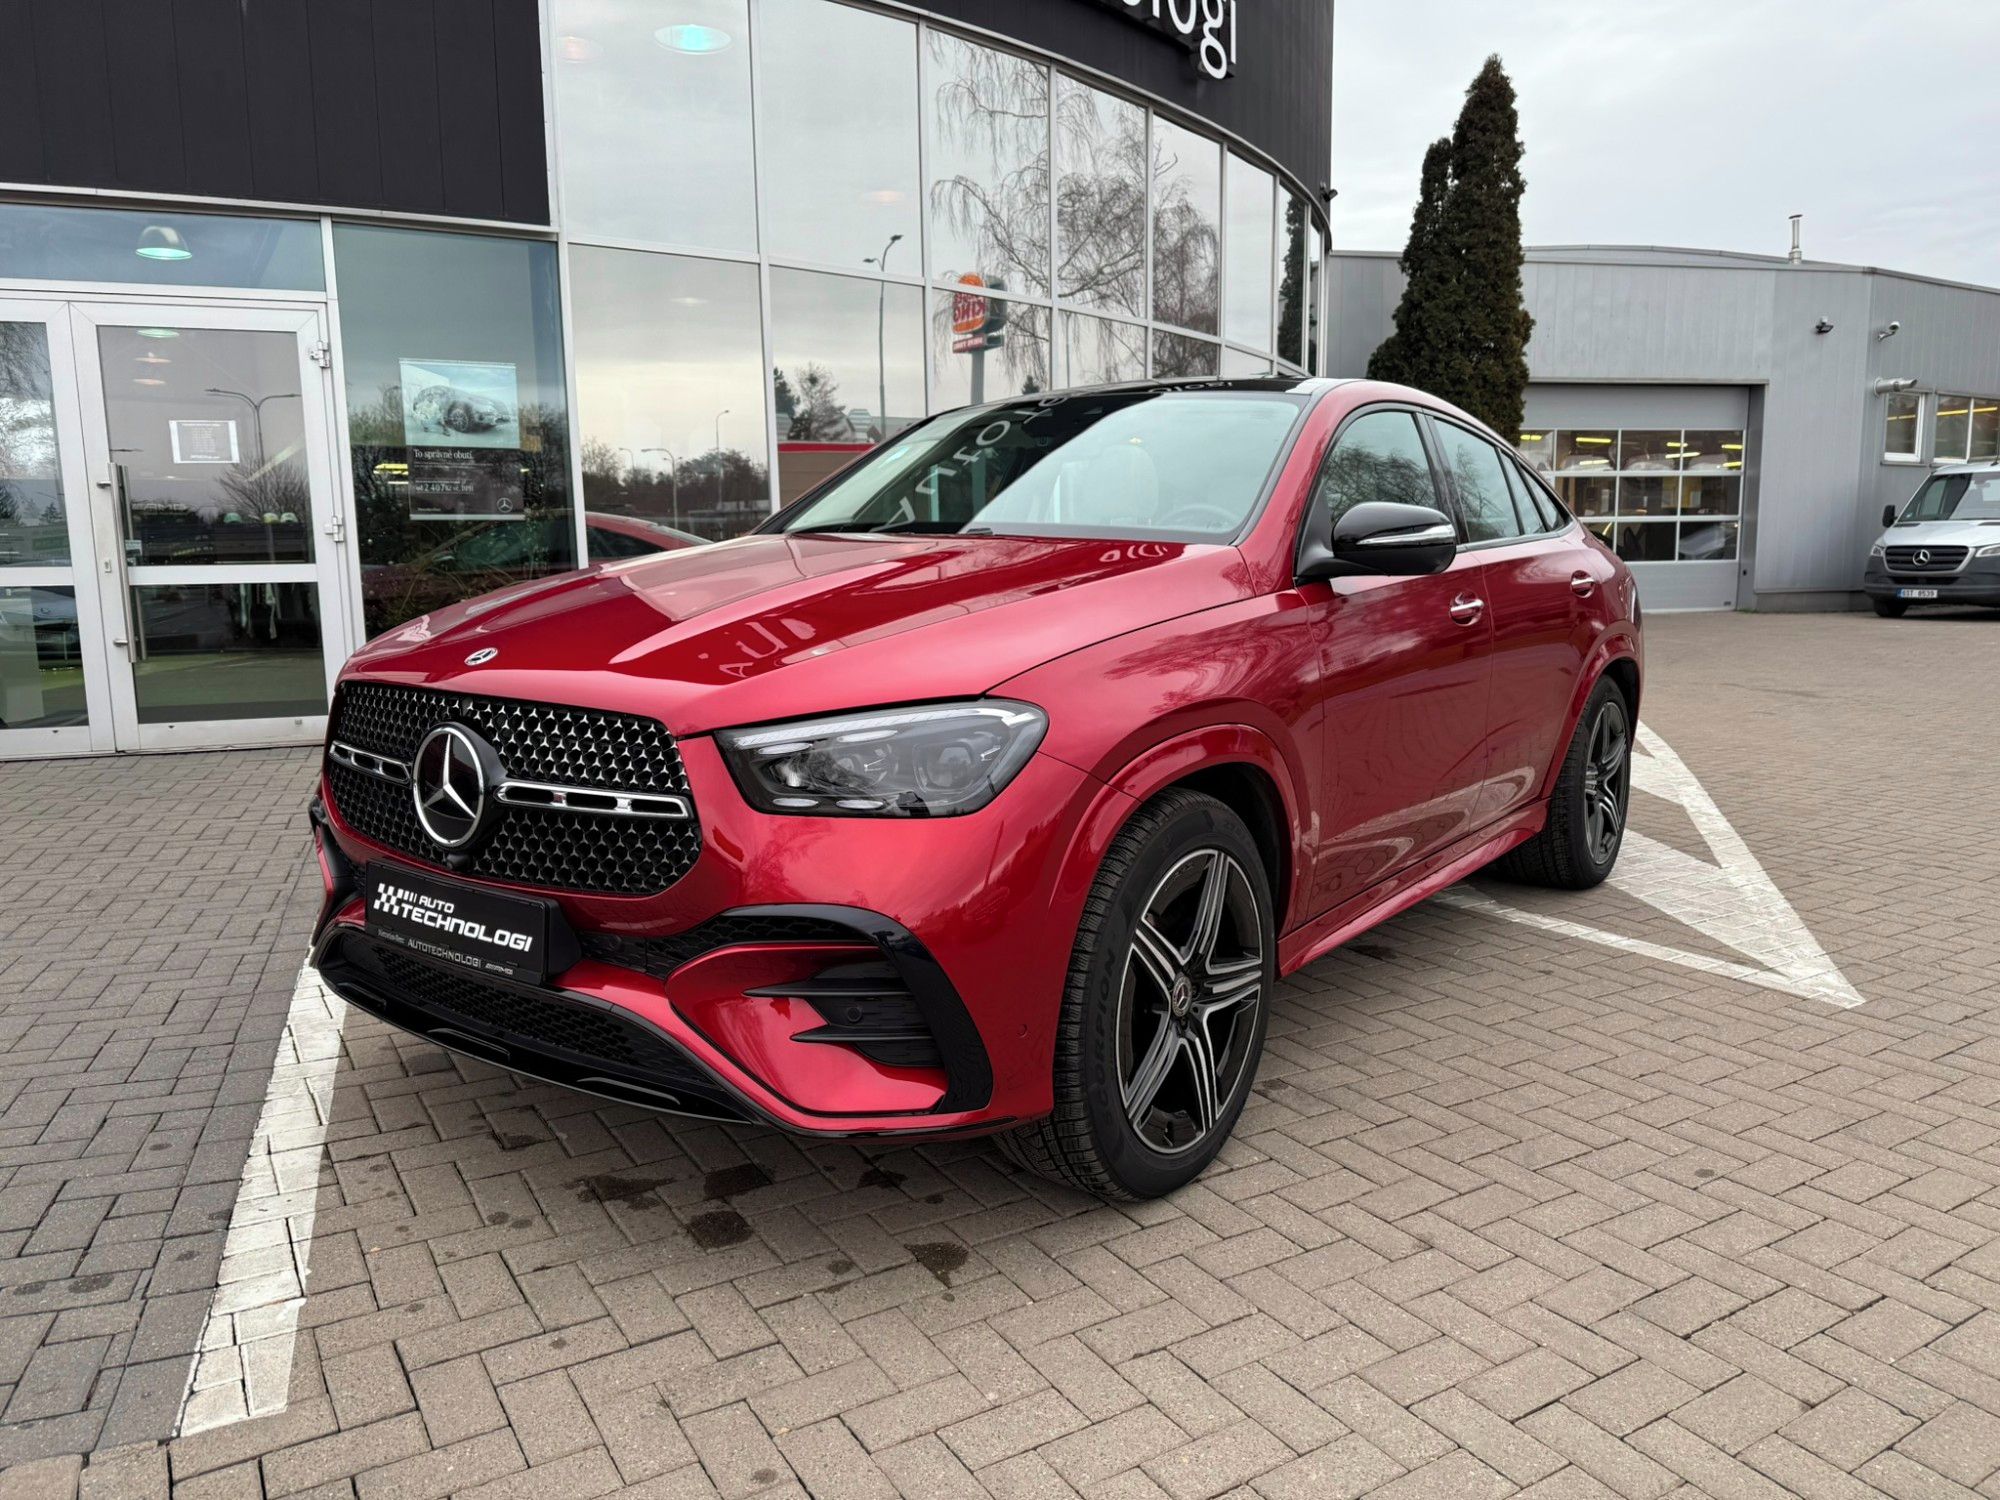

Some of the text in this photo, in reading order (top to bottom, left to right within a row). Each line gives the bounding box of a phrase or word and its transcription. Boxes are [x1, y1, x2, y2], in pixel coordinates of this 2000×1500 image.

[413, 449, 423, 458] To
[419, 895, 454, 913] AUTO
[401, 903, 533, 952] TECHNOLOGI
[407, 938, 482, 968] AUTOTECHNOLOGI
